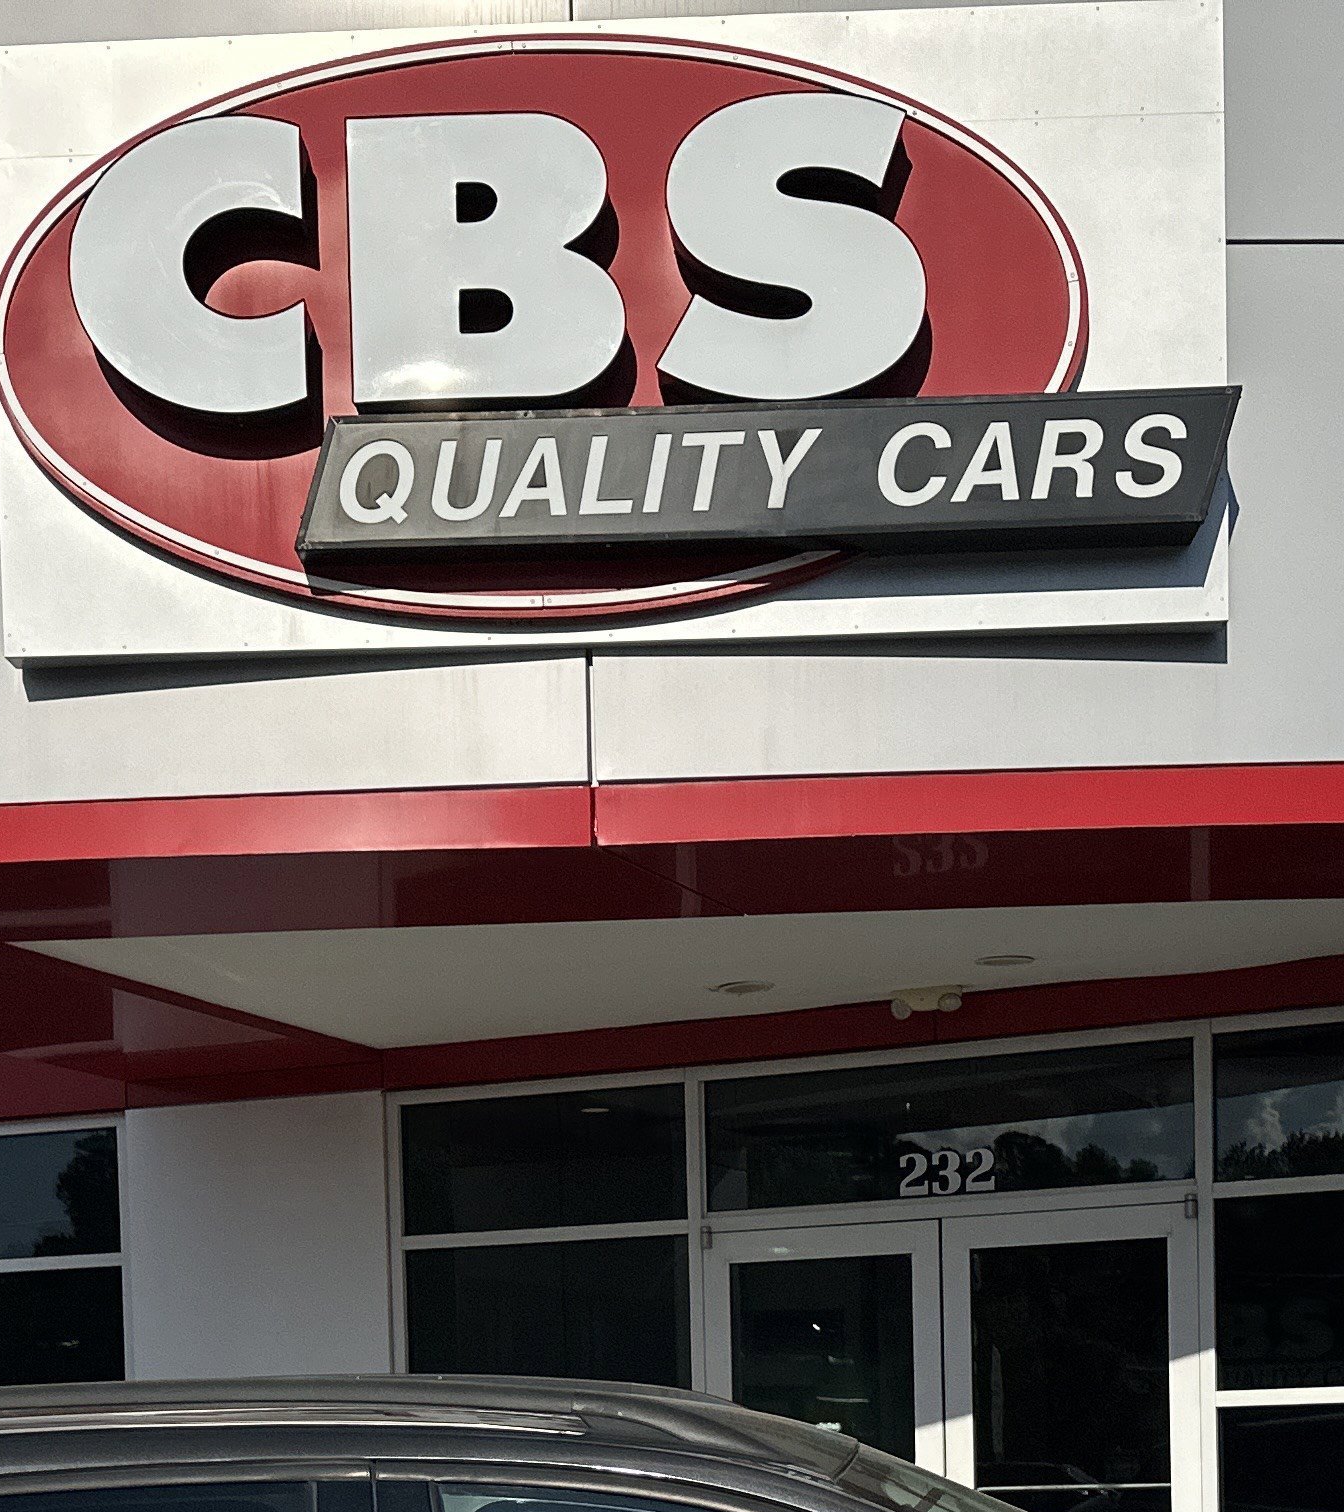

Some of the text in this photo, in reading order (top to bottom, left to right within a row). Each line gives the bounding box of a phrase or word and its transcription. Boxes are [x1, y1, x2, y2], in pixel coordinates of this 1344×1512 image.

[70, 92, 926, 413] CBS
[338, 412, 1189, 526] QUALITY CARS
[899, 1148, 996, 1197] 232
